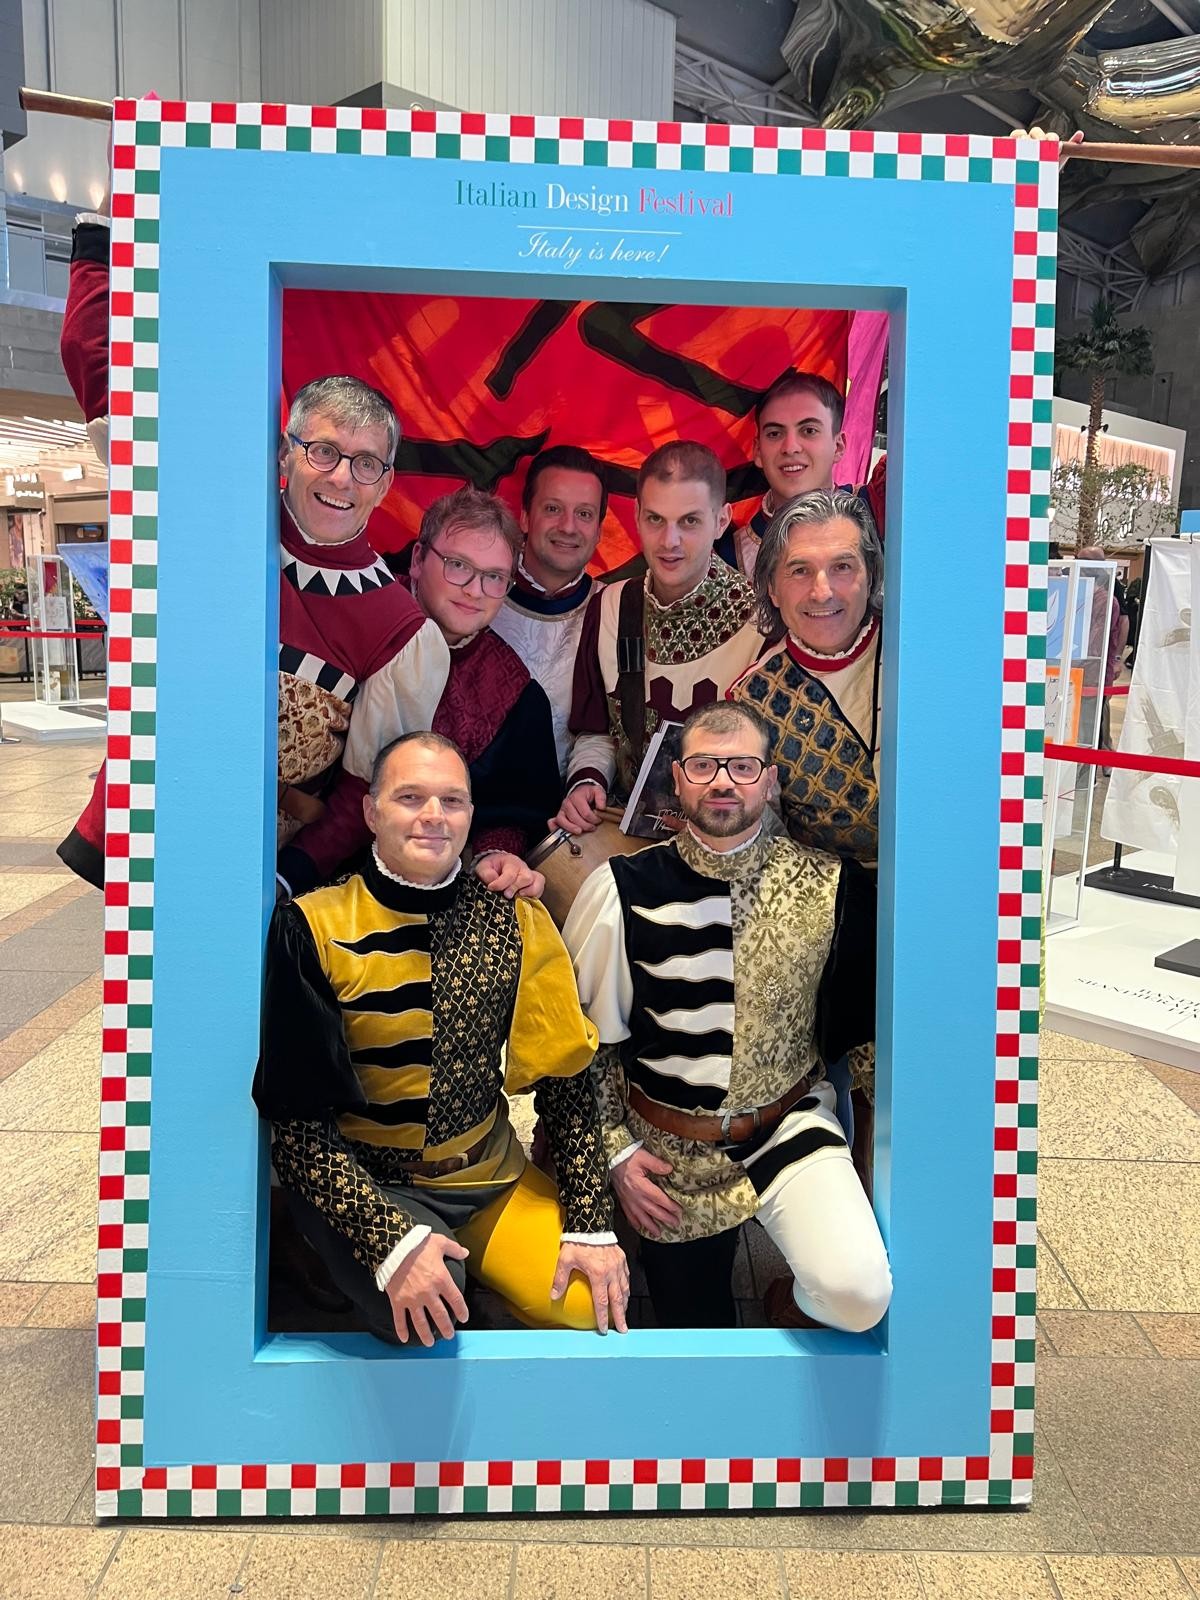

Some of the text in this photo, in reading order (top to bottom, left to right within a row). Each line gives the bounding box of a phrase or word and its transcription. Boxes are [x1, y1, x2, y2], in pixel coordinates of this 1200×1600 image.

[455, 179, 734, 217] Italian Design Festival
[518, 231, 670, 270] Italy is here!
